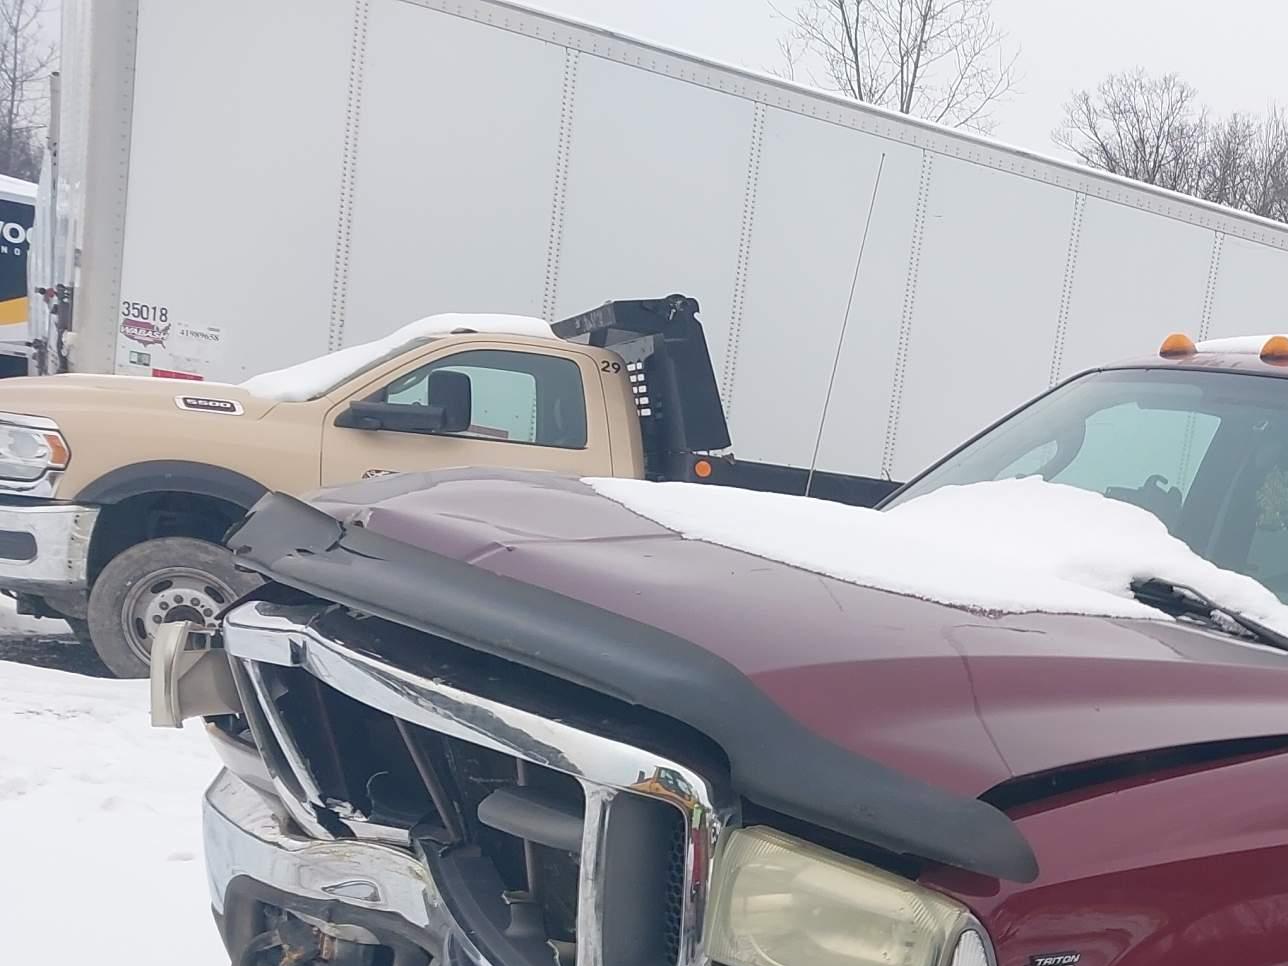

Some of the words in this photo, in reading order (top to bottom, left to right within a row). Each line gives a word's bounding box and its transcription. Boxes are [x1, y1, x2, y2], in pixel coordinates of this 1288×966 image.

[121, 301, 168, 322] 35018
[601, 360, 621, 373] 29
[1035, 953, 1080, 966] TRITON
